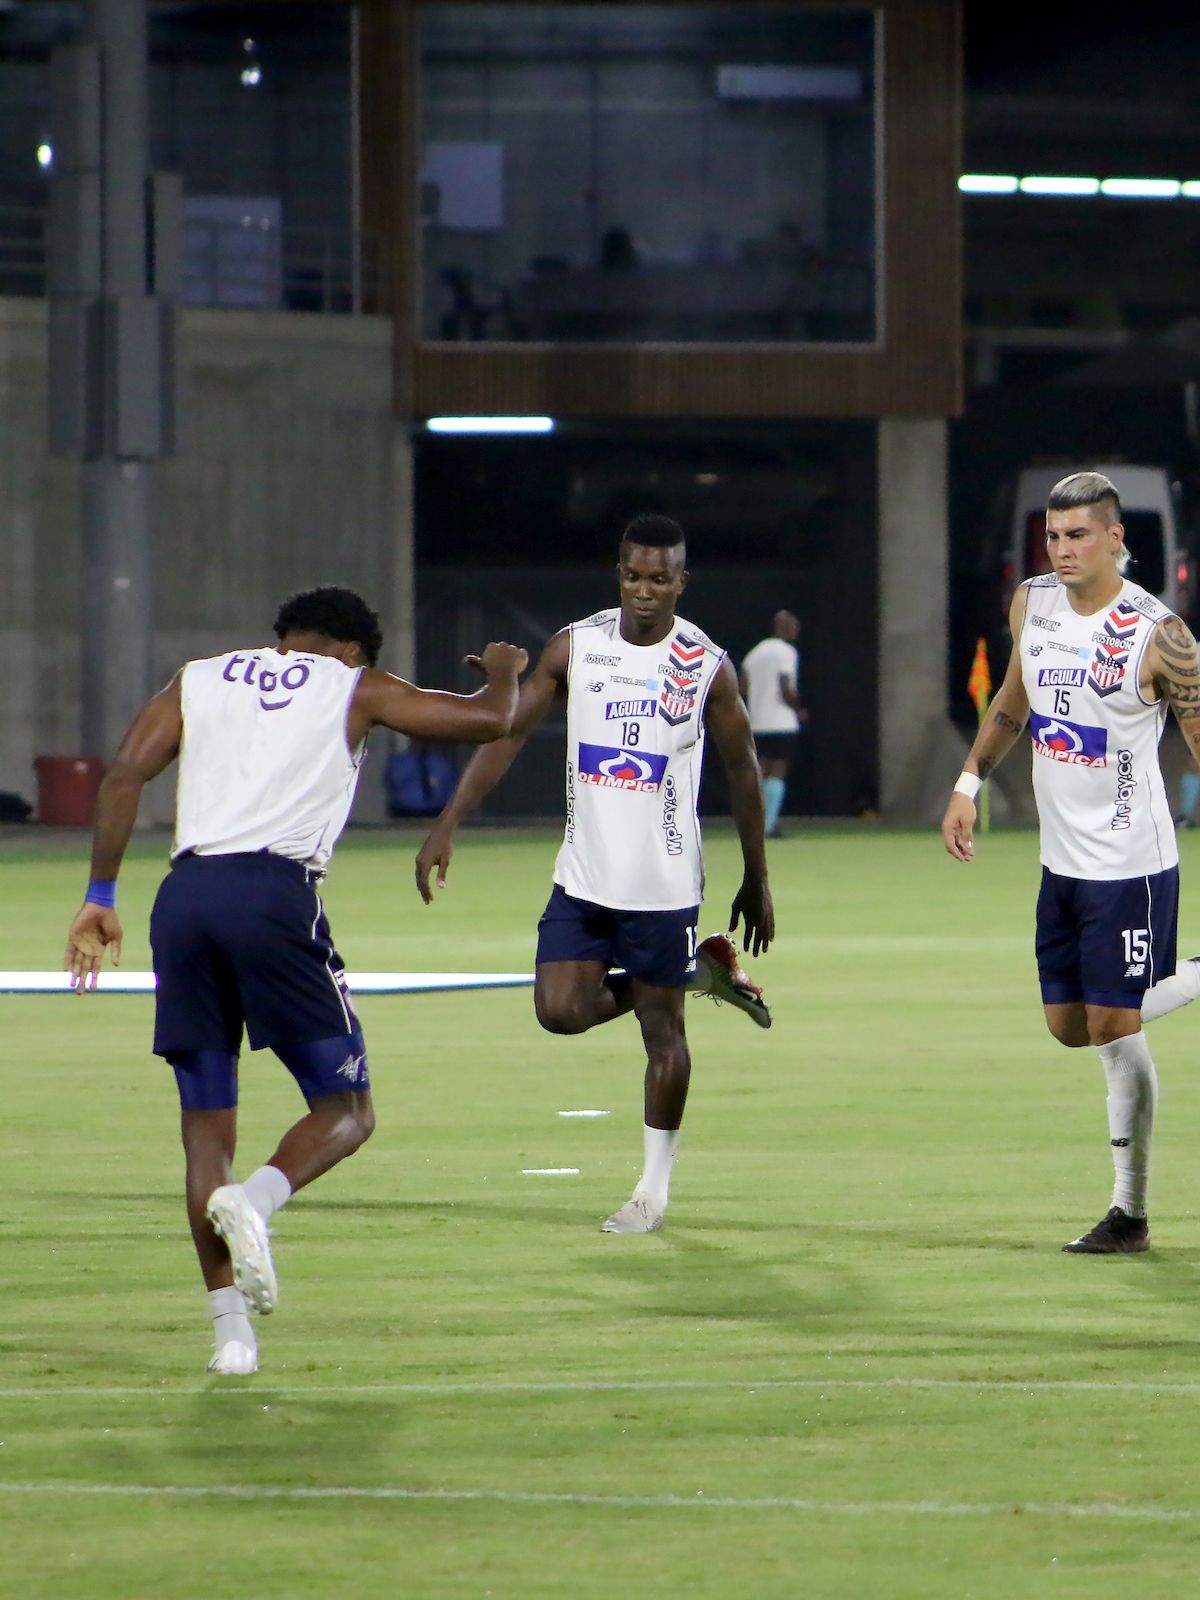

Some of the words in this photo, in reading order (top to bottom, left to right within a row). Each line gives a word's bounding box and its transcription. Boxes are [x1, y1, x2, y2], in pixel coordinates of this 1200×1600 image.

[1092, 632, 1134, 650] POSTOBON
[658, 664, 702, 682] POSTOBON
[1040, 671, 1083, 686] AGUILA
[609, 700, 653, 718] AGUILA
[1054, 688, 1070, 715] 15
[622, 721, 640, 746] 18
[1031, 737, 1105, 768] LIMPICA
[663, 775, 683, 856] wplay.co
[1121, 929, 1149, 962] 15
